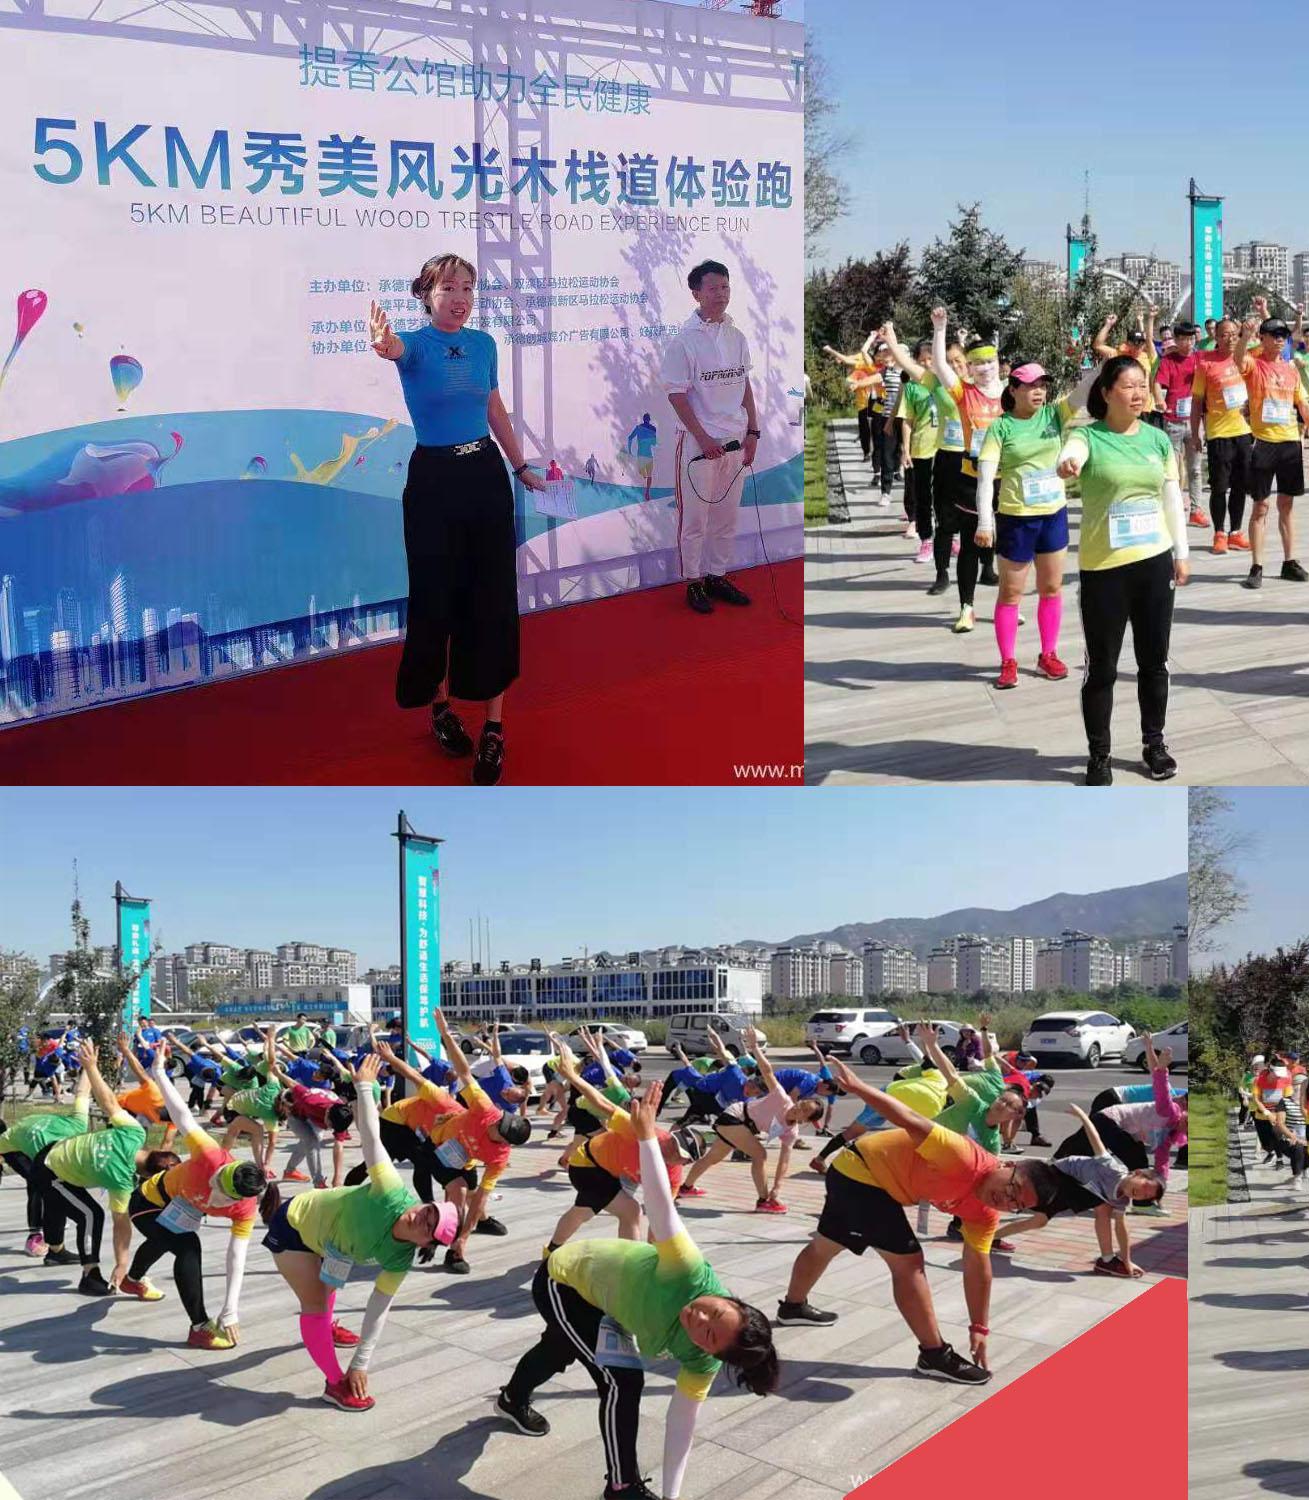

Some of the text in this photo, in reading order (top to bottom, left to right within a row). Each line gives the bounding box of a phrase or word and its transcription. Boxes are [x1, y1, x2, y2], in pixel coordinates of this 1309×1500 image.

[298, 42, 653, 116] 提香公馆助力全民健康
[33, 117, 793, 210] 5KM秀美风光木栈道体验跑
[130, 202, 750, 233] 5KM BEAUTIFUL WOOD TRESTLE ROAD EXPERIENCE RUN
